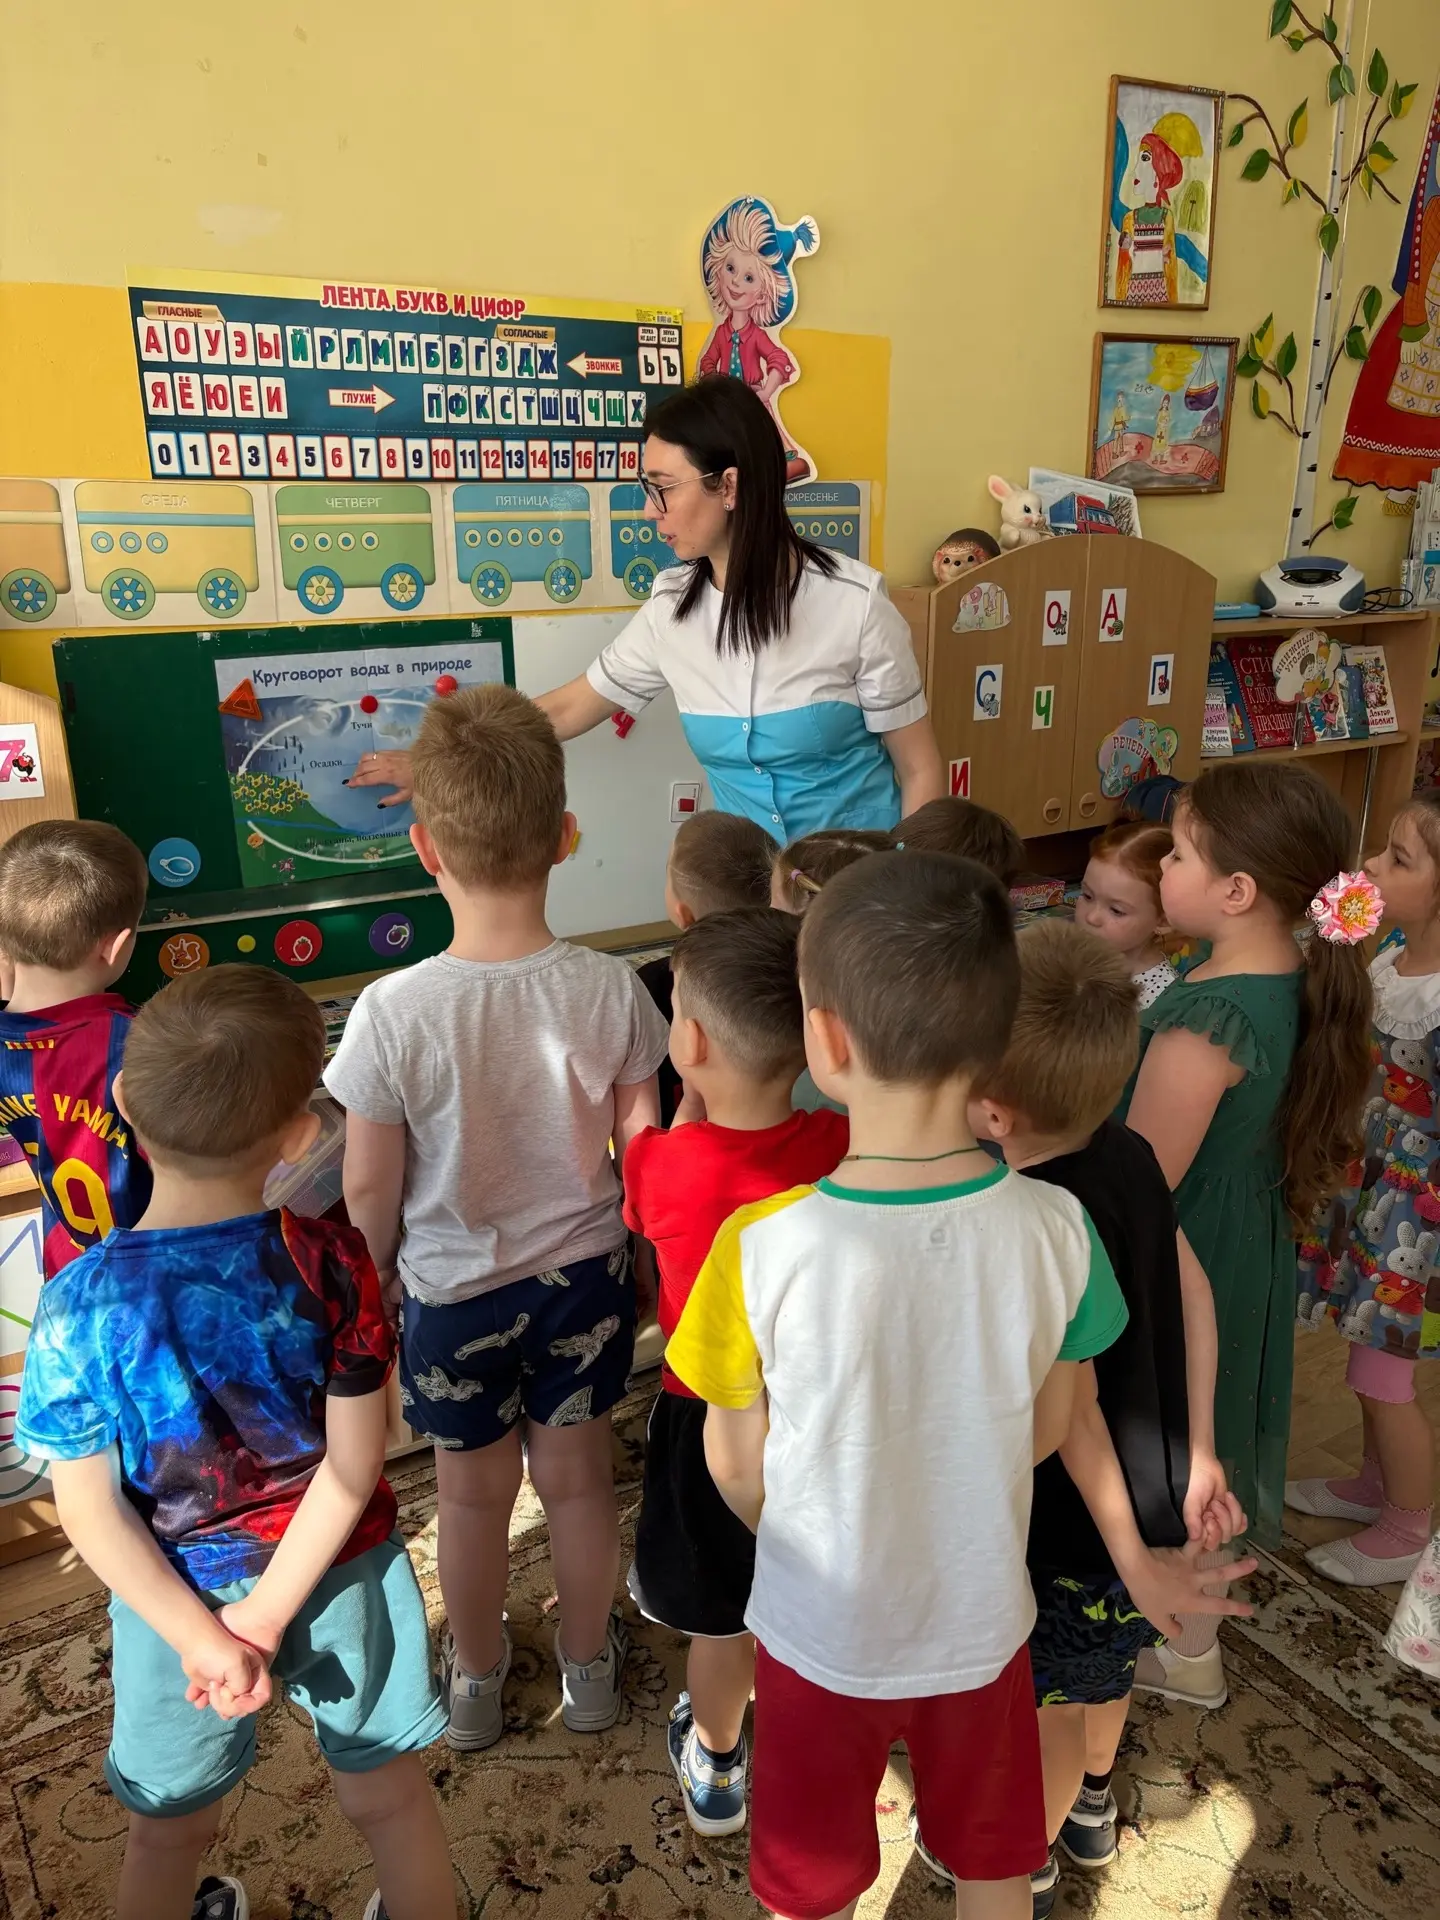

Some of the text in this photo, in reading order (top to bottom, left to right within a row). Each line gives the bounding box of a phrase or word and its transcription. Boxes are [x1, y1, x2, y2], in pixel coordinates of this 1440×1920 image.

[157, 305, 202, 318] ГЛАСНЫЕ
[322, 285, 525, 320] ЛЕНТА БУКВ И ЦИФР
[503, 328, 548, 340] СОГЛАСНЫЕ
[145, 326, 558, 376] А О У Э Ы Й Р Л М Н Б В Г З Д Ж
[586, 360, 620, 372] ЗВОНКИЕ
[644, 355, 677, 376] Ь Ъ
[152, 376, 283, 412] Я Ё Ю Е И
[342, 392, 377, 405] ГЛУХИЕ
[428, 394, 442, 418] П
[449, 392, 467, 418] Ф
[476, 394, 490, 419] К
[501, 394, 512, 420] С
[522, 396, 534, 420] Т
[542, 395, 560, 421] Ш
[566, 396, 580, 423] Ц
[588, 398, 600, 422] Ч
[608, 398, 625, 424] Щ
[158, 444, 636, 470] 0 1 2 3 4 5 6 7 8 9 10 11 12 13 14 15 16 17 18
[326, 497, 382, 508] ЧЕТВЕРГ
[496, 496, 549, 508] ПЯТНИЦА
[784, 492, 838, 502] СКРЕСЕНЬЕ
[1047, 593, 1118, 629] О А
[1285, 645, 1310, 672] УГОЛОК
[252, 659, 472, 686] Круговорот воды в природе
[976, 661, 1169, 708] С П
[1036, 690, 1052, 726] Ч
[1204, 704, 1224, 712] ТИХИ
[1204, 713, 1226, 726] КАЗКИ
[351, 722, 372, 732] Тучи
[0, 740, 26, 782] 7
[310, 758, 342, 768] Осадки
[952, 761, 968, 797] И
[53, 1094, 128, 1159] YAMA
